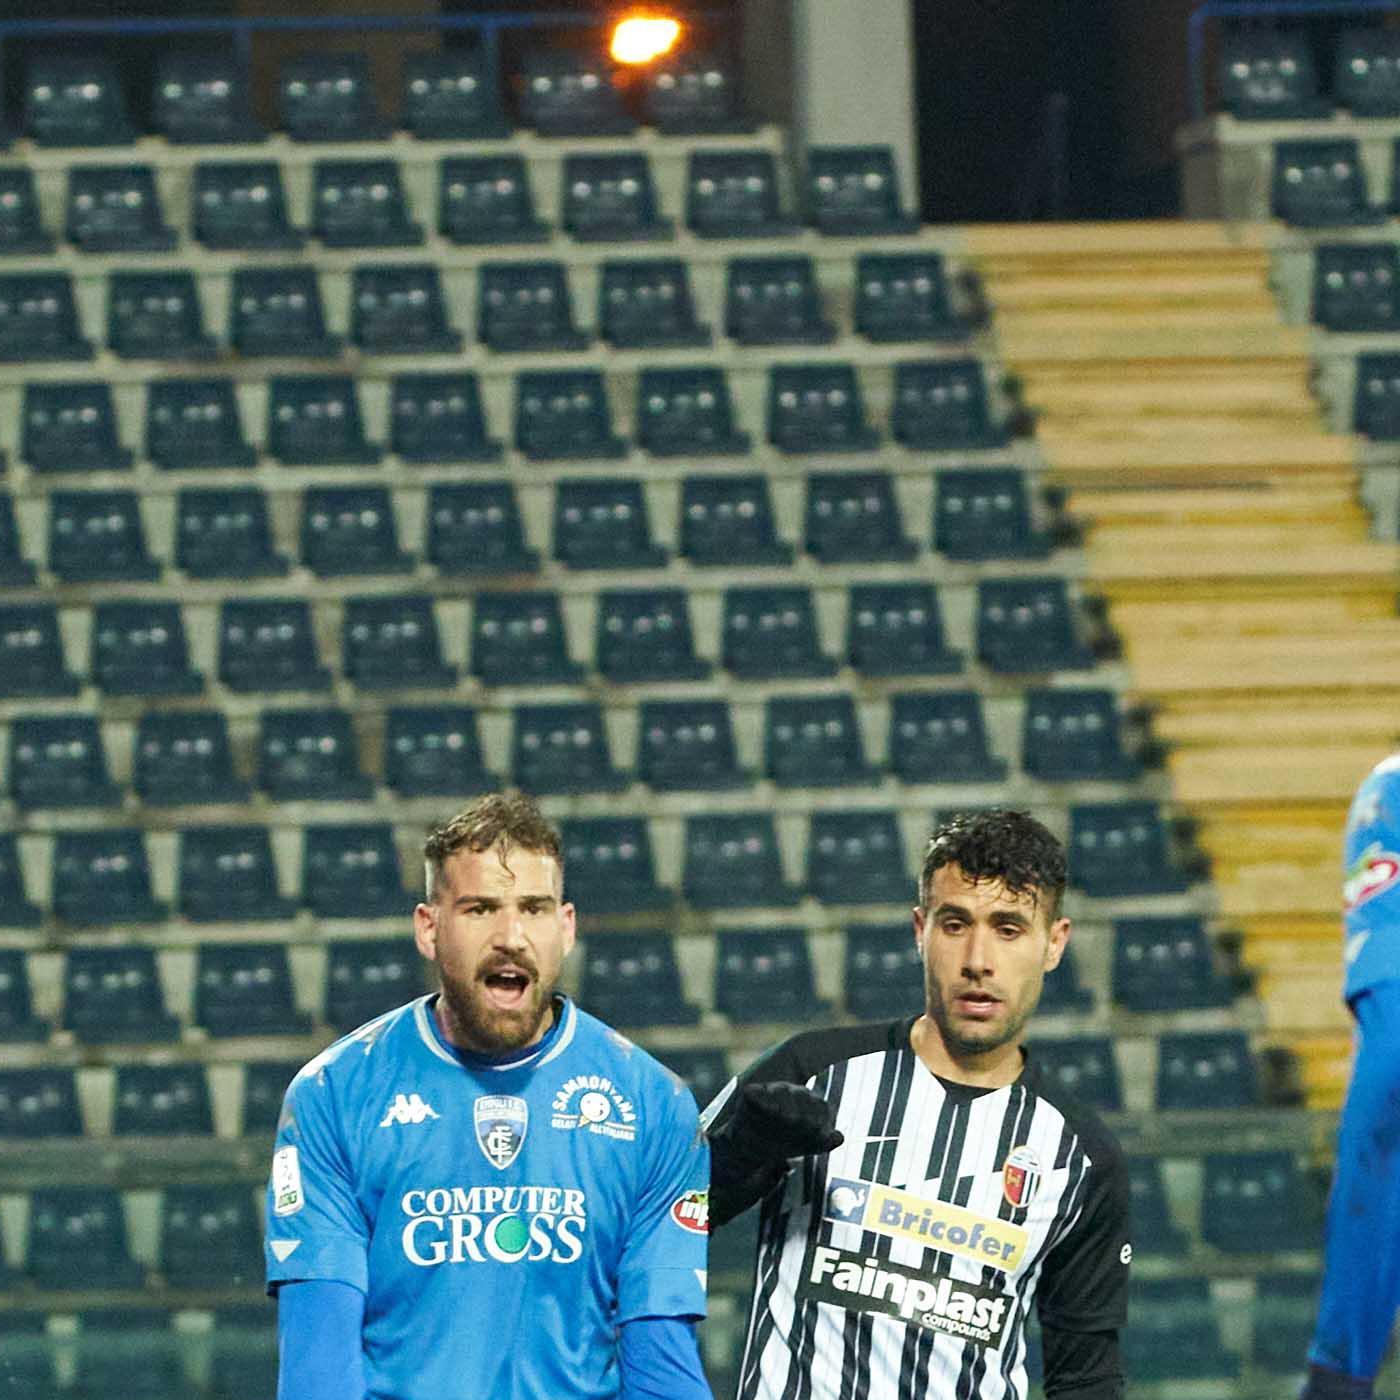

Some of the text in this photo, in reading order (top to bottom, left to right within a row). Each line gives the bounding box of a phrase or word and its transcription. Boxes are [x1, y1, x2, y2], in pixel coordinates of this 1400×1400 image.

[401, 1186, 587, 1217] COMPUTER
[402, 1212, 587, 1267] GROSS
[878, 1198, 1017, 1263] Bricofer
[809, 1246, 1005, 1333] Fainplast
[921, 1311, 992, 1342] compounds
